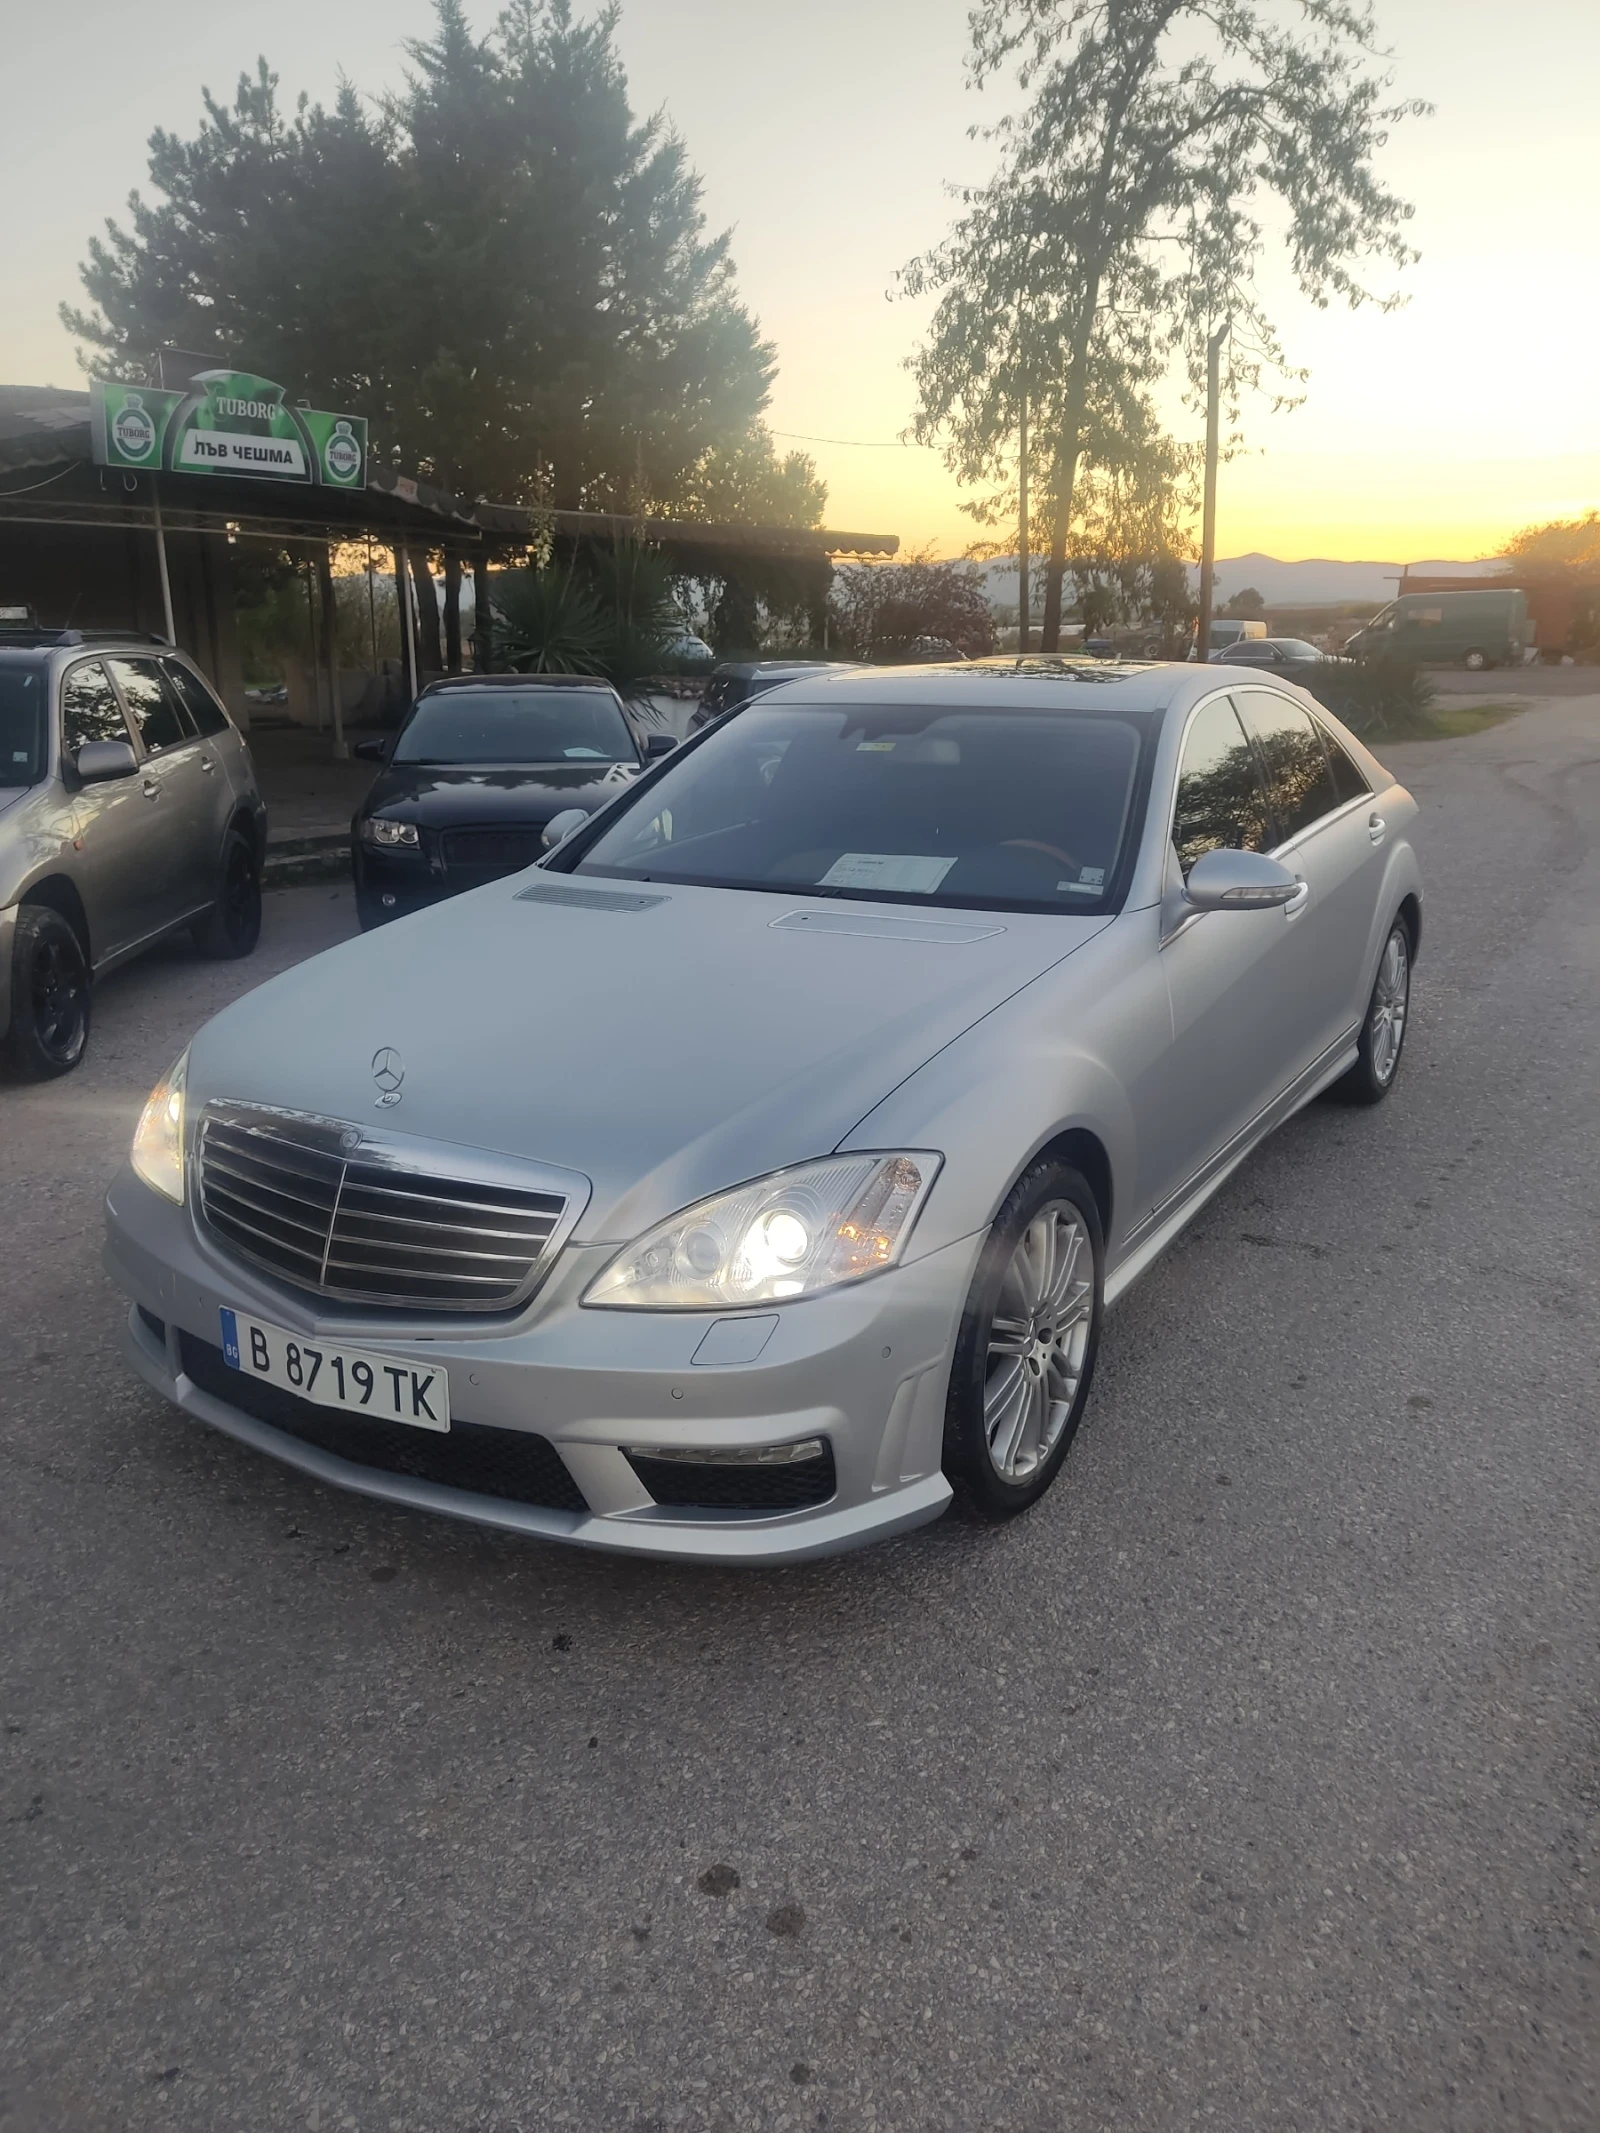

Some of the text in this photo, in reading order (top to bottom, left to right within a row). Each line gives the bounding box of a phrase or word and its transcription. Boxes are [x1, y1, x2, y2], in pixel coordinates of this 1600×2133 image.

[216, 396, 276, 420] TUBORG
[117, 426, 150, 439] TUBORG
[233, 445, 293, 464] ЧЕШМА
[329, 451, 357, 463] TUBORG
[226, 1343, 238, 1359] BG
[250, 1326, 438, 1421] B 8719 TK
